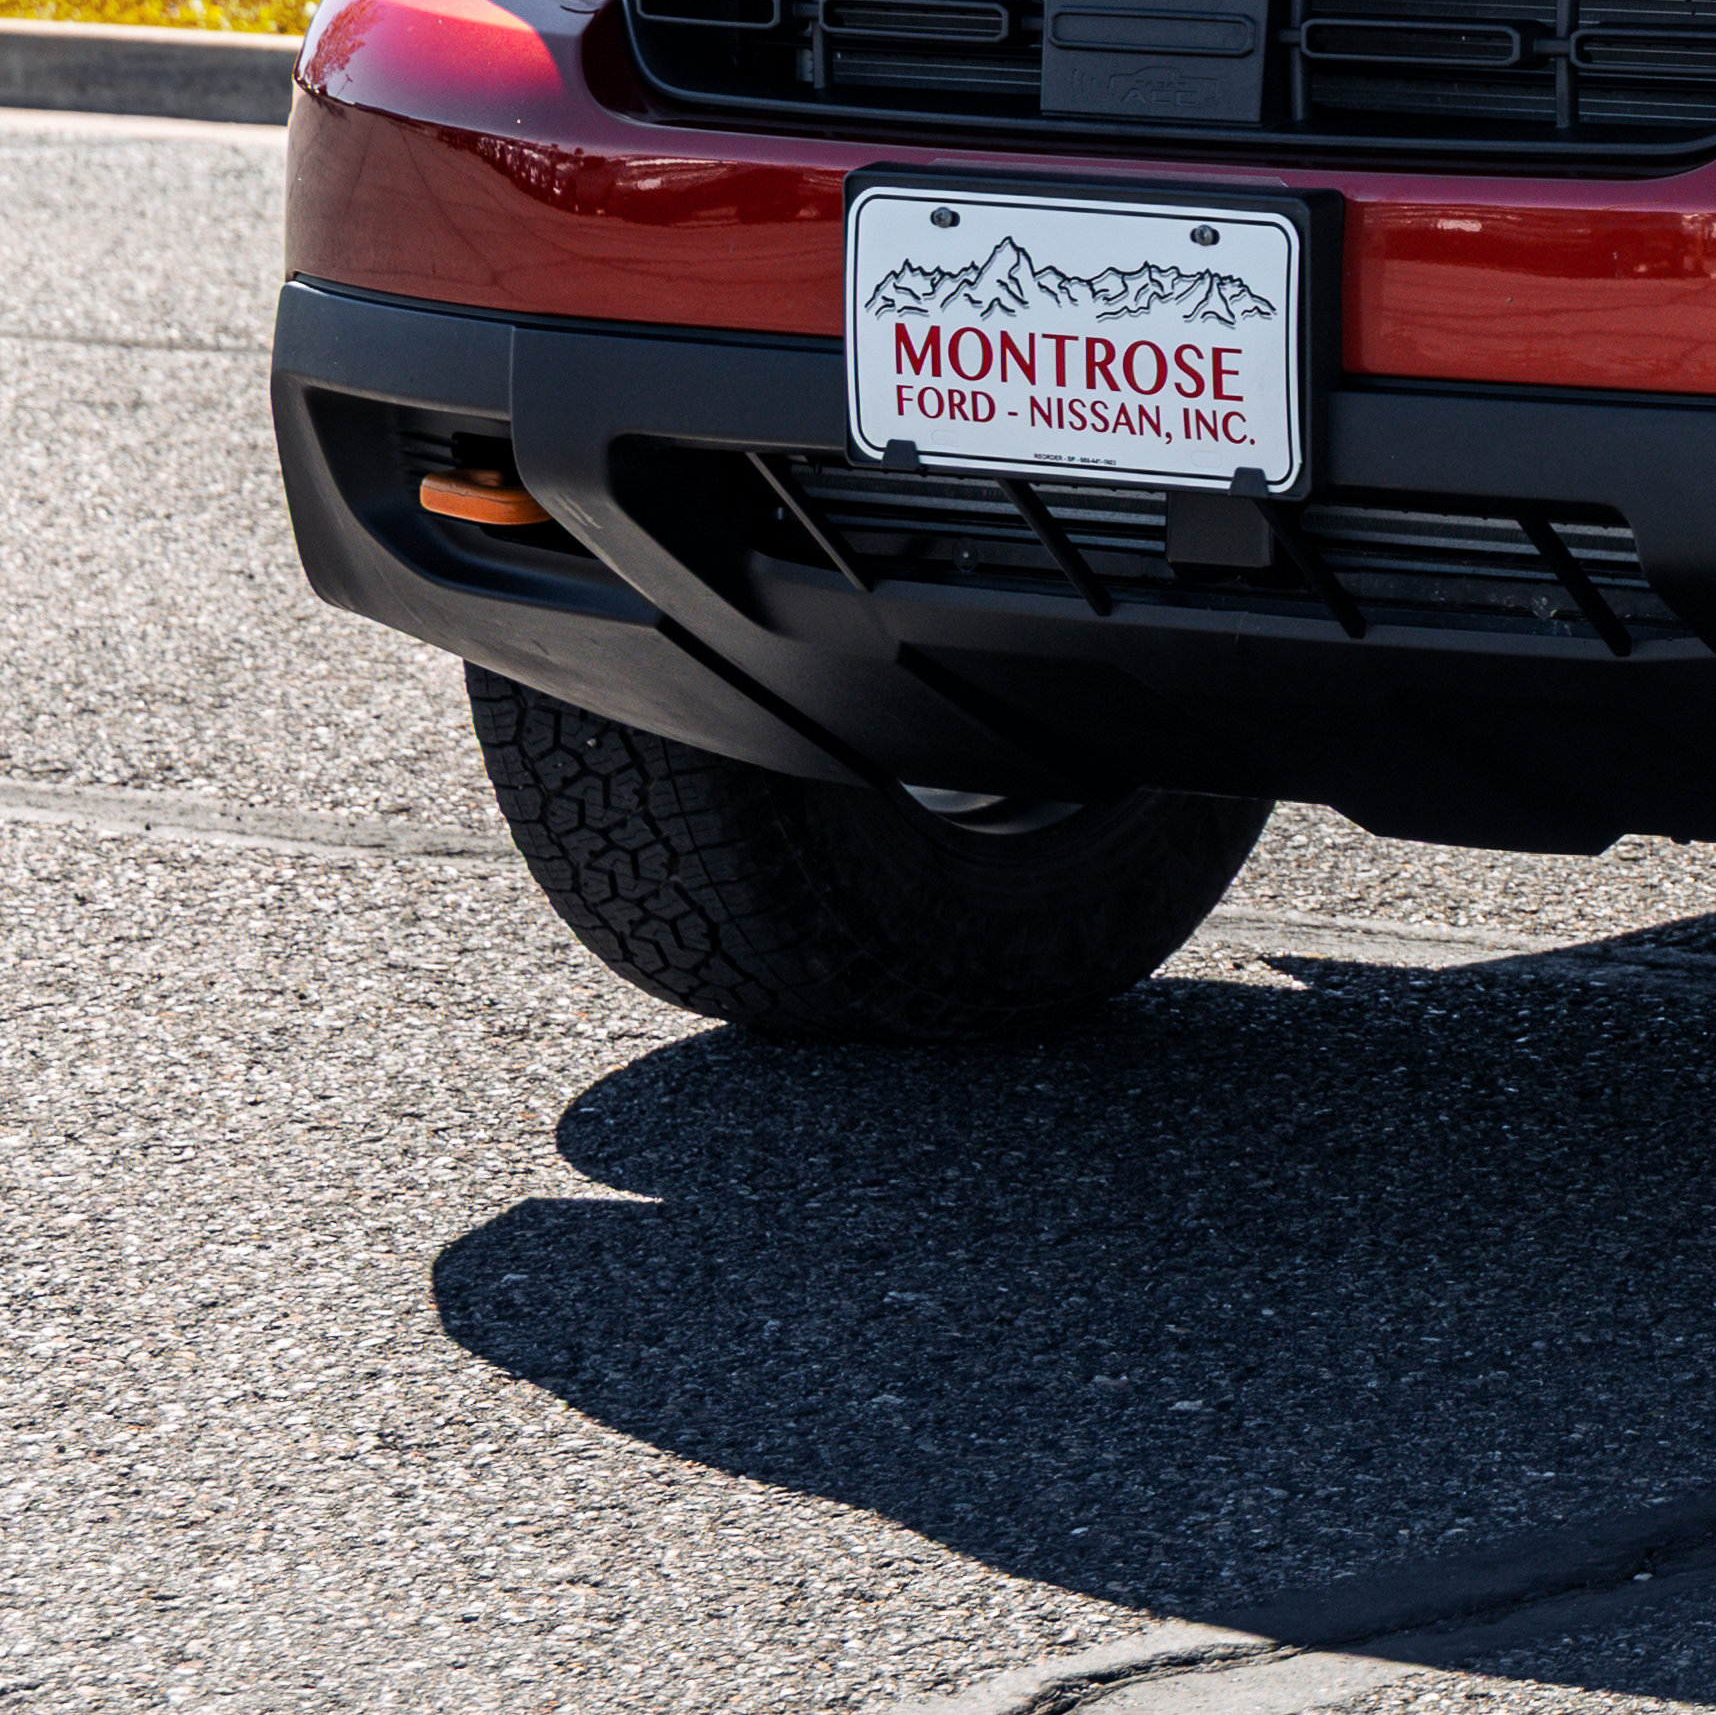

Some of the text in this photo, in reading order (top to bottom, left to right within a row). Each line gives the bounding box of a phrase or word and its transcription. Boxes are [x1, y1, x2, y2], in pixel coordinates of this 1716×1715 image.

[894, 322, 1244, 402] MONTROSE
[896, 384, 996, 423] FORD
[1029, 395, 1173, 445] NISSAN,
[1183, 407, 1256, 446] INC.
